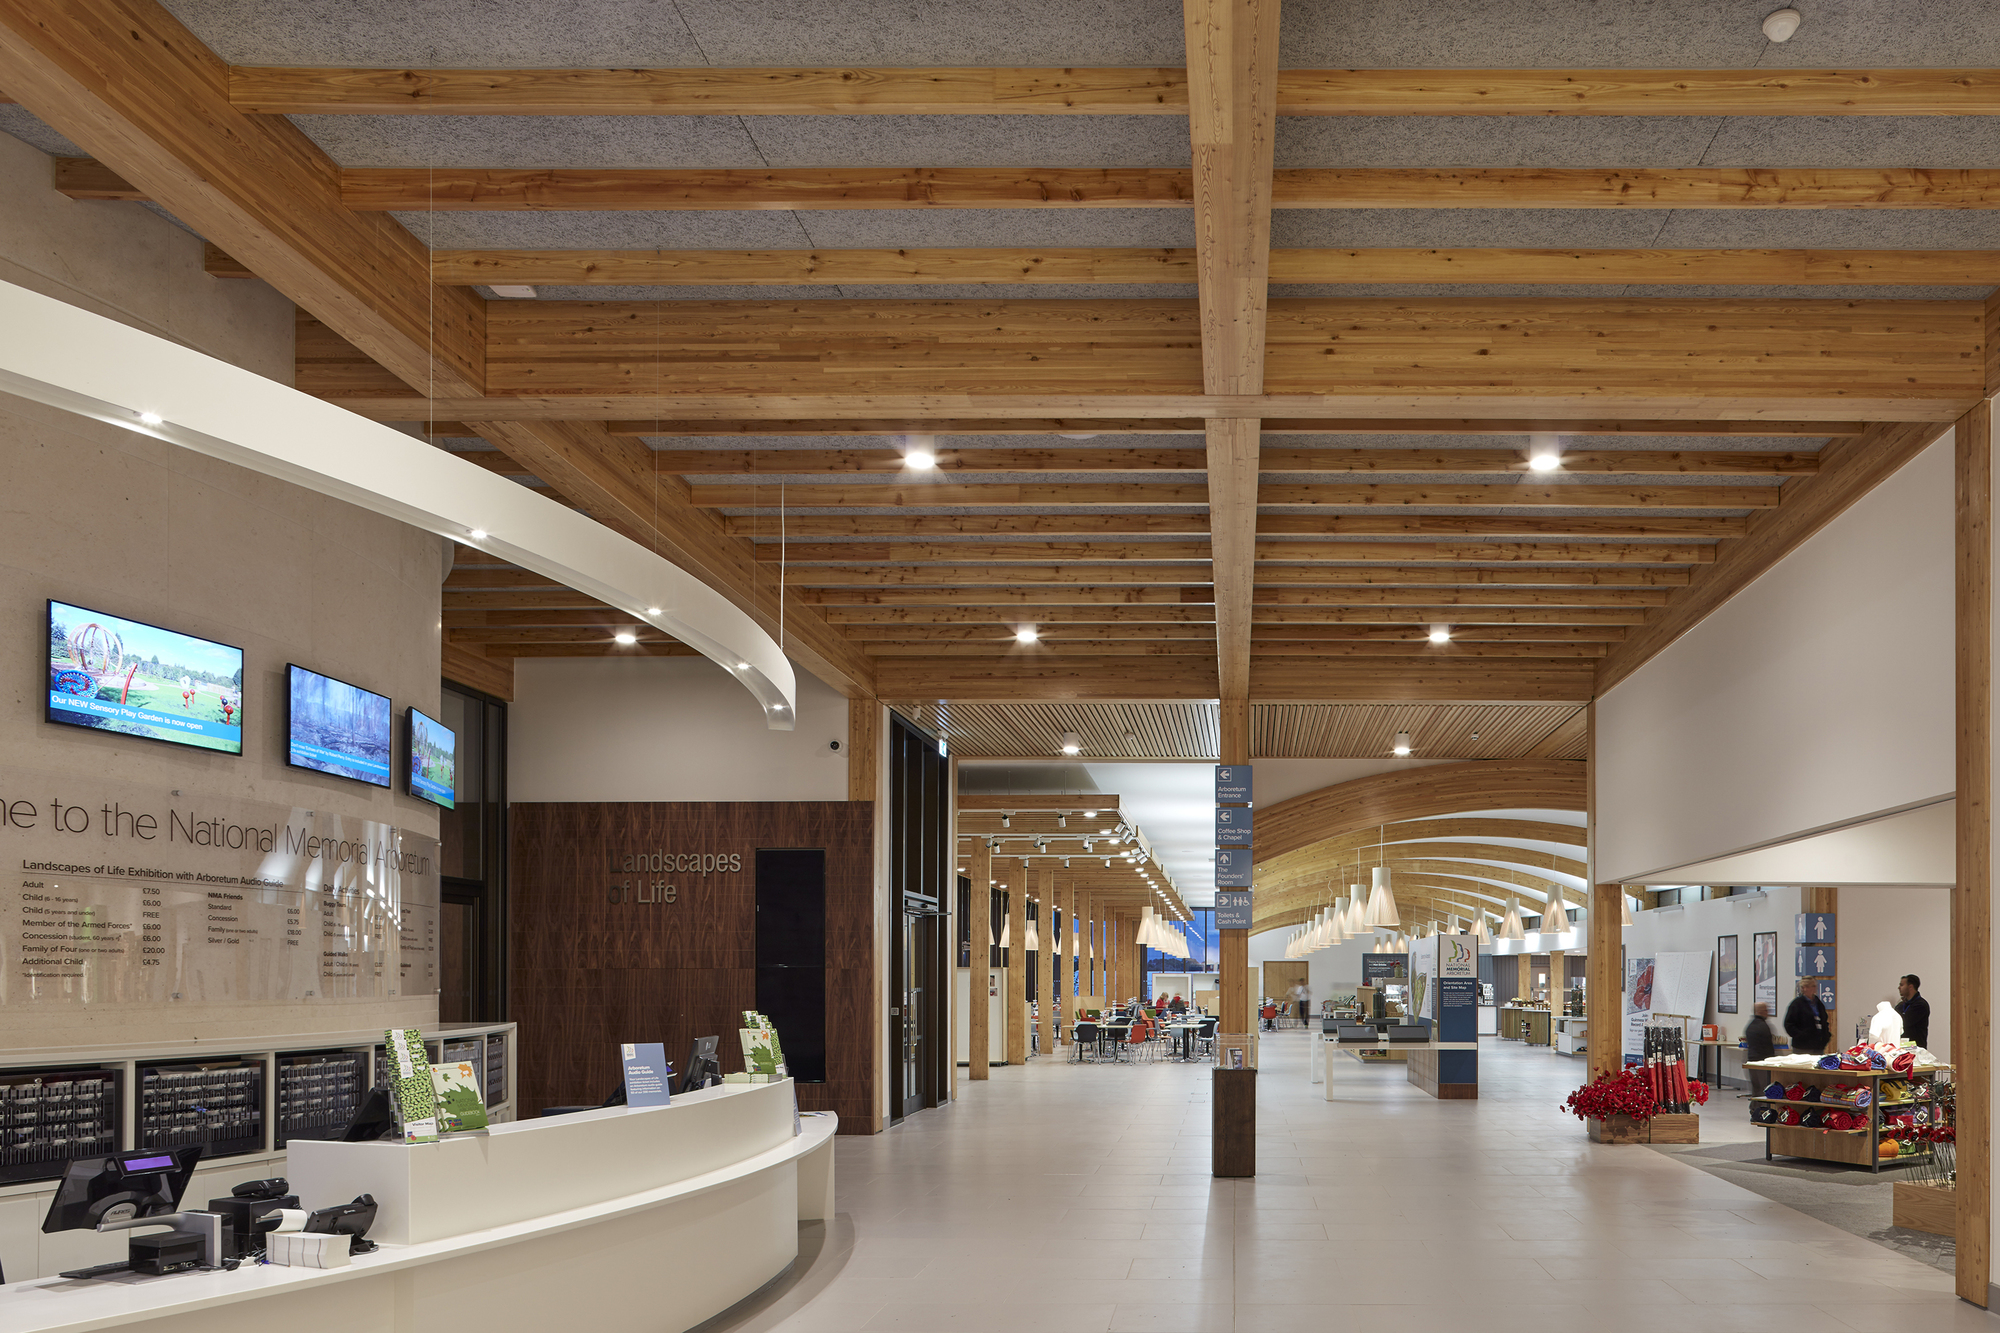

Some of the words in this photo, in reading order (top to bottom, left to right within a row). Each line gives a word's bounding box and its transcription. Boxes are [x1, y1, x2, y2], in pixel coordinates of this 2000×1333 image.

[52, 695, 67, 705] Our
[68, 698, 89, 708] NEW
[90, 702, 119, 715] Sensory
[121, 707, 137, 718] Play
[138, 712, 163, 723] Garden
[186, 721, 203, 730] open
[50, 798, 89, 833] to
[101, 802, 158, 839] the
[171, 809, 277, 853] National
[286, 825, 370, 865] Memorial
[375, 841, 430, 876] Arboretum
[23, 860, 91, 874] Landscapes
[94, 865, 105, 874] of
[108, 866, 125, 875] Life
[128, 867, 173, 879] Exhibition
[176, 871, 194, 880] with
[196, 873, 238, 884] Arboretum
[240, 876, 262, 886] Audio
[263, 879, 284, 888] Guide
[609, 848, 741, 877] Landscapes
[608, 880, 630, 903] of
[638, 880, 677, 903] Life
[22, 945, 48, 953] Family
